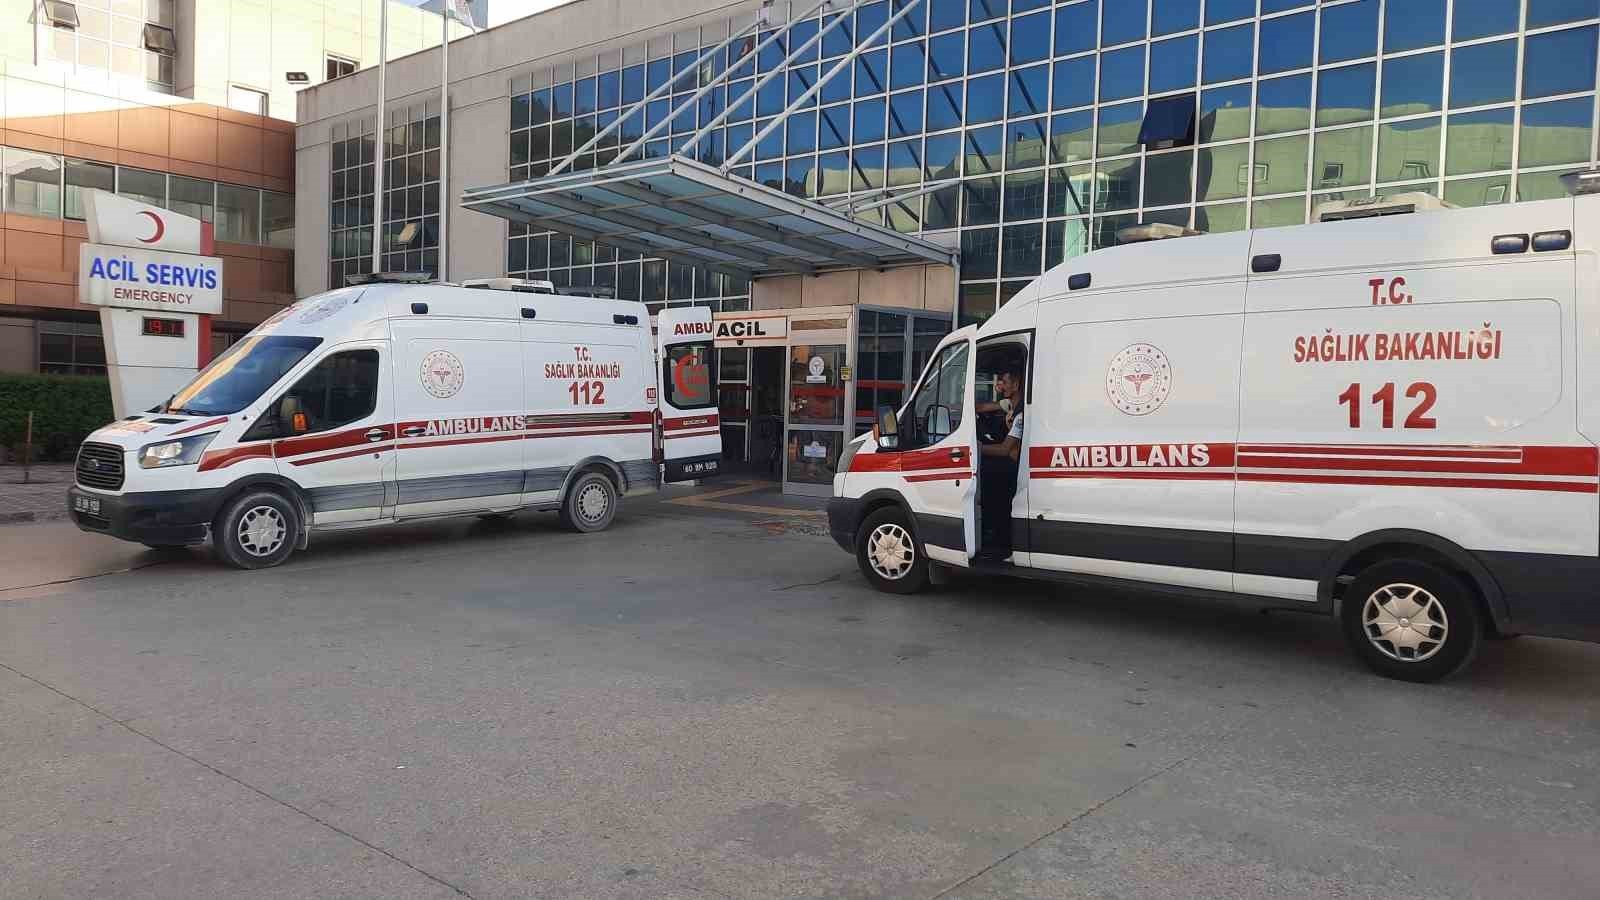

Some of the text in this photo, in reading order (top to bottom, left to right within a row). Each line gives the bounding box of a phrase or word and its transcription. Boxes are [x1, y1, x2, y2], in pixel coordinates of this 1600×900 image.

[89, 255, 217, 290] ACİL SERVİS
[114, 287, 193, 305] EMERGENCY
[1368, 277, 1413, 305] T.C.
[574, 346, 592, 362] T.C.
[1294, 328, 1370, 363] SAĞLIK
[544, 361, 576, 379] SAĞLIK
[568, 381, 605, 405] 112
[1338, 382, 1437, 429] 112
[424, 415, 526, 437] AMBULANS
[1050, 444, 1210, 468] AMBULANS
